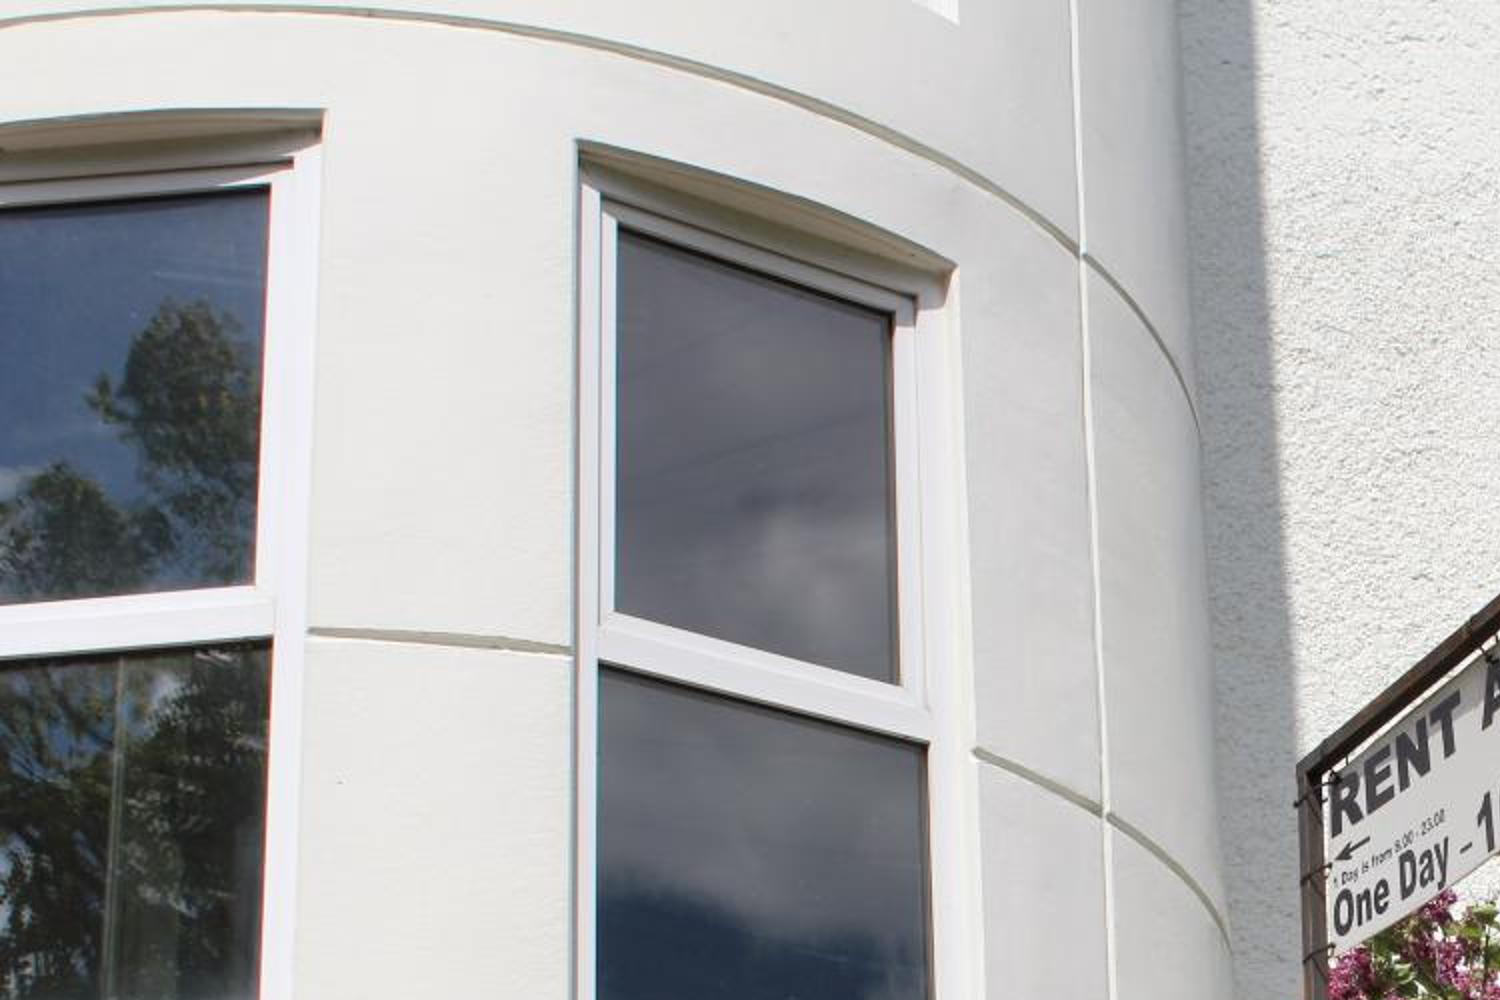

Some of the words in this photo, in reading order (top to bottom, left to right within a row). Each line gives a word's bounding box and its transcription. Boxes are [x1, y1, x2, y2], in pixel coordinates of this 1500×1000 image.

[1329, 689, 1461, 838] RENT
[1333, 878, 1390, 936] One
[1398, 836, 1449, 901] Day
[1341, 867, 1359, 885] Day
